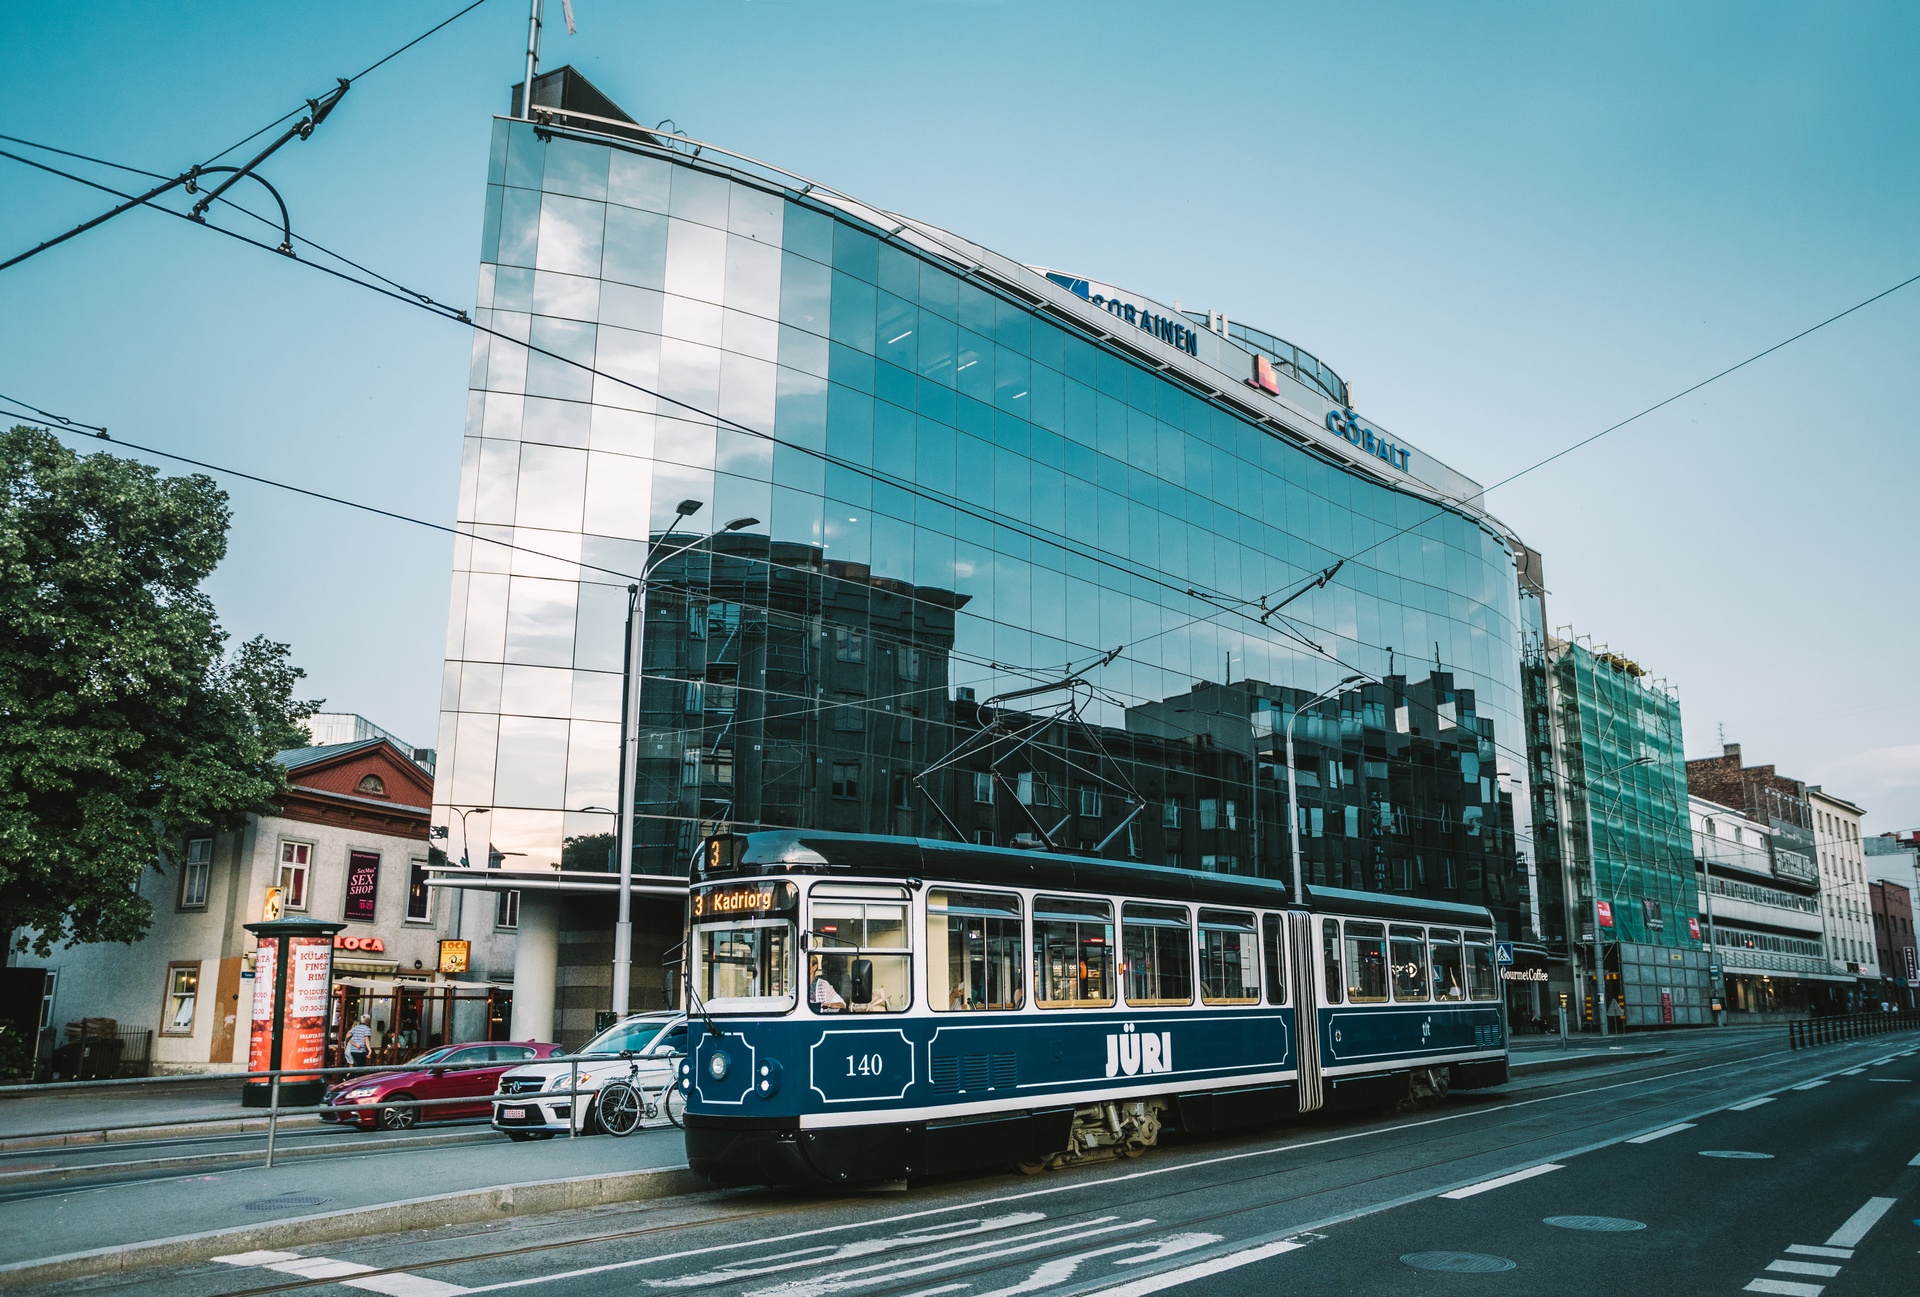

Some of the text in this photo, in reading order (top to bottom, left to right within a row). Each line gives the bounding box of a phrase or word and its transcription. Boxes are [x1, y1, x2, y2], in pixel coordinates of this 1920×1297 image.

[710, 840, 720, 867] 3
[350, 885, 374, 895] SHOP
[351, 874, 374, 886] SEX
[694, 891, 772, 916] 3 Kadriorg
[333, 934, 385, 952] LOCA
[442, 941, 467, 949] LOCA
[1105, 1022, 1173, 1078] JÜRI
[845, 1053, 883, 1077] 140
